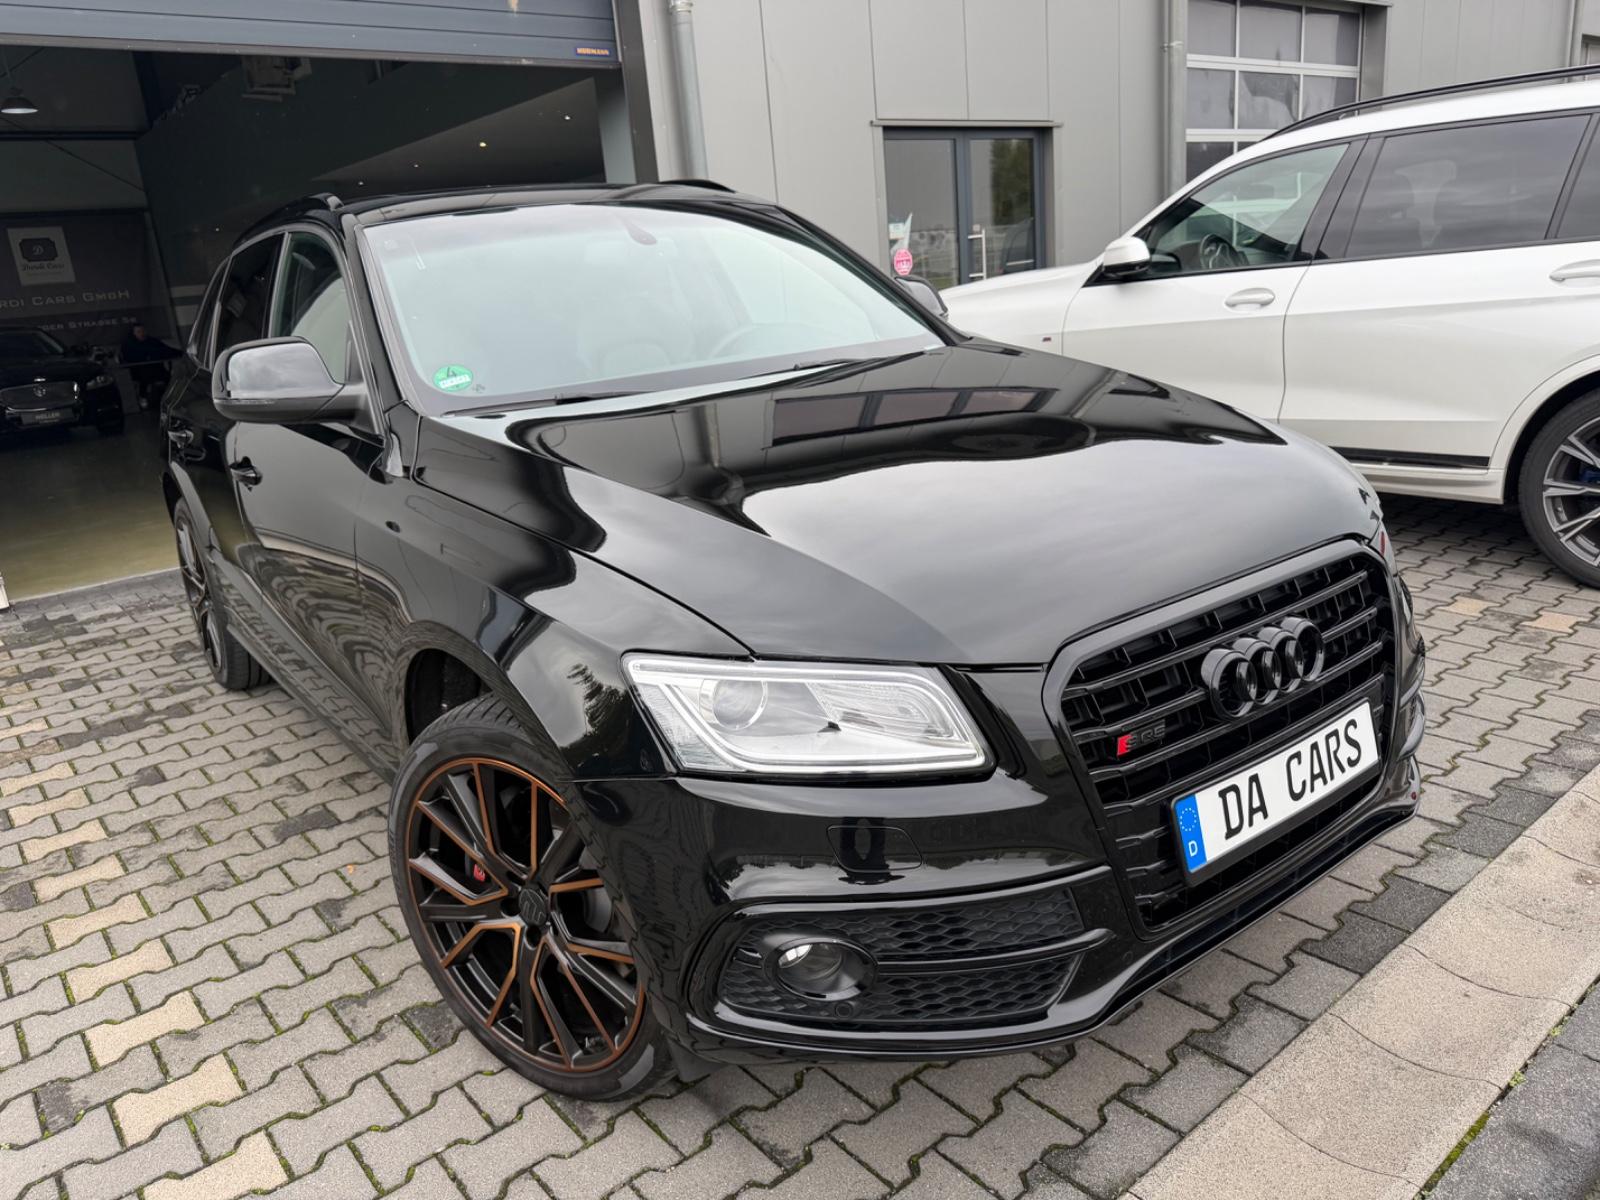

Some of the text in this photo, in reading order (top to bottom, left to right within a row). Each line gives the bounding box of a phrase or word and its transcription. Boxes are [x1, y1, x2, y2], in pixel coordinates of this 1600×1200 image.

[1218, 718, 1362, 841] DA CARS
[1188, 840, 1198, 857] D
